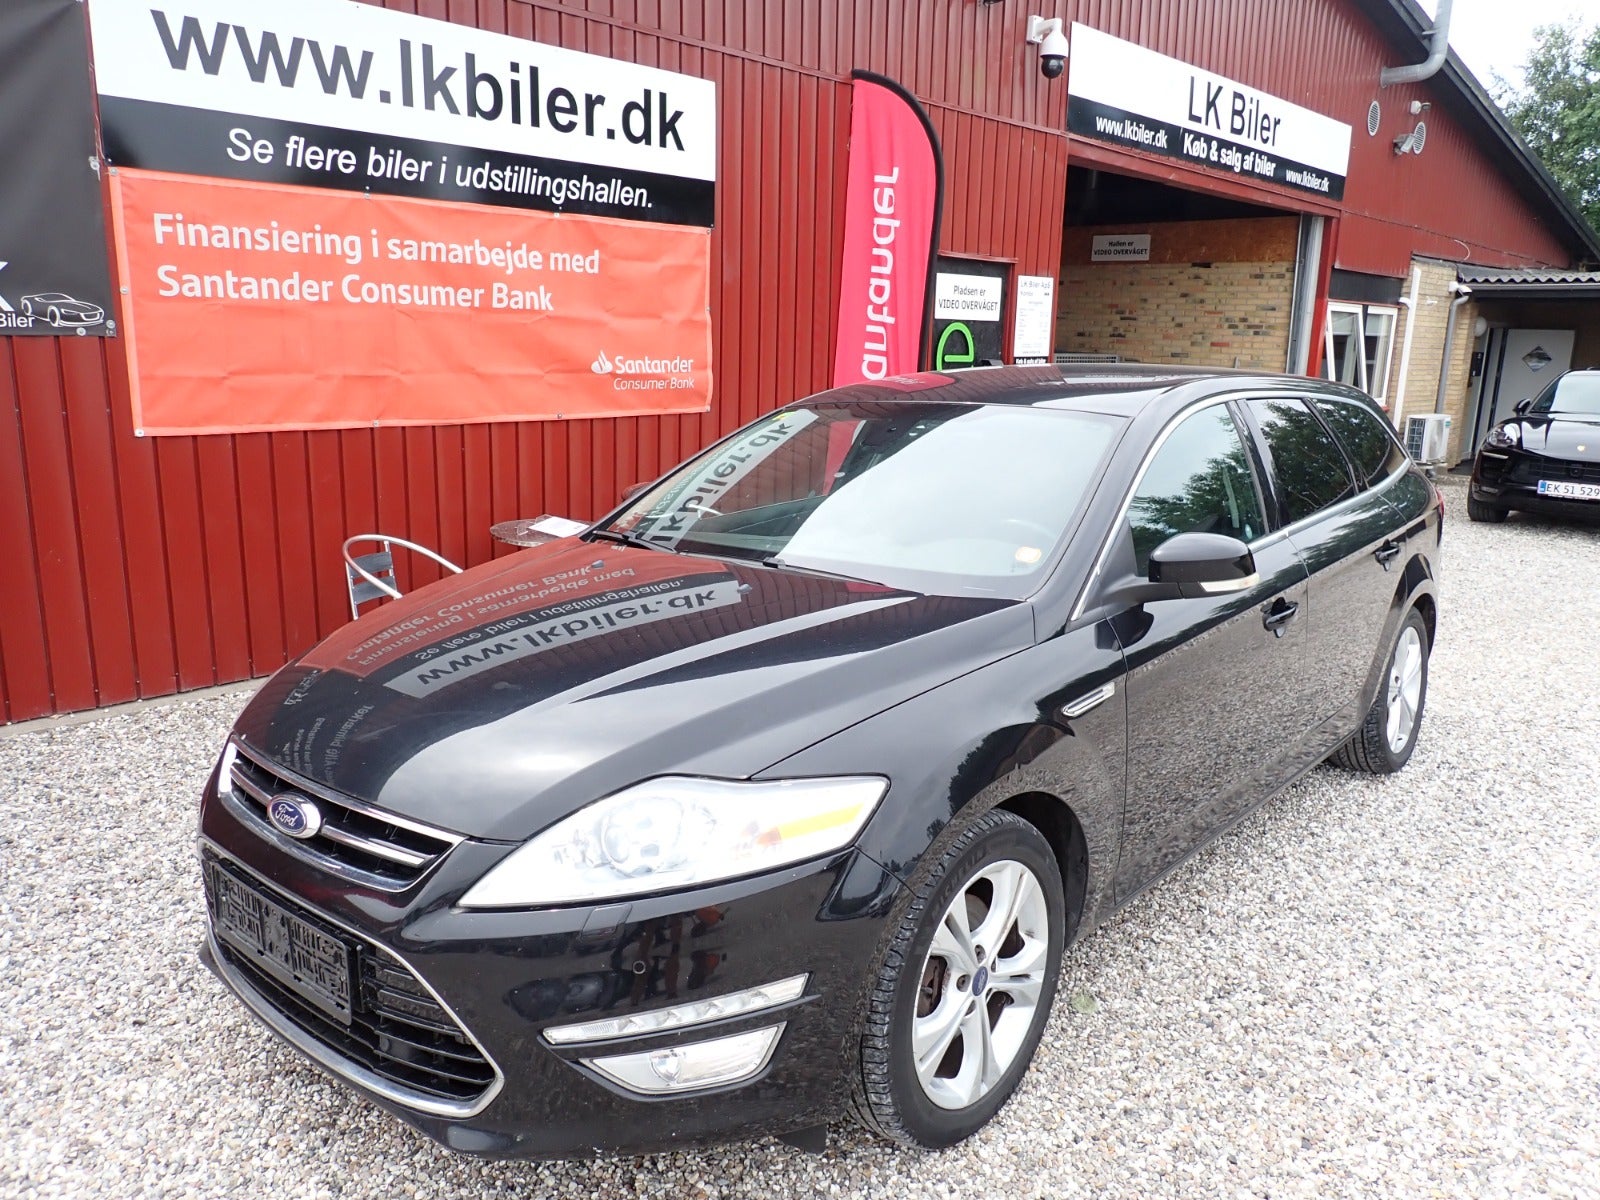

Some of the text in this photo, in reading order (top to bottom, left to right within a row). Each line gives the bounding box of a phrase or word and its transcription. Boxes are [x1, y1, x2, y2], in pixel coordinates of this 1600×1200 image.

[150, 9, 685, 151] www.lkbiler.dk
[1187, 76, 1281, 147] LK Biler
[1095, 116, 1168, 149] www.lkbiler.dk
[226, 127, 653, 208] Se flere biler i udstillingshallen.
[1183, 132, 1277, 177] Køb & salg af biler
[153, 212, 600, 275] Finansiering i samarbejde med
[156, 264, 555, 311] Santander Consumer Bank
[953, 285, 986, 297] Pladsen er
[938, 298, 998, 311] VIDEO OVERVÅGET
[614, 355, 694, 374] Santander
[613, 377, 695, 391] Consumer Bank
[1546, 483, 1560, 492] EK
[1563, 485, 1575, 494] 51
[275, 803, 299, 827] Ford
